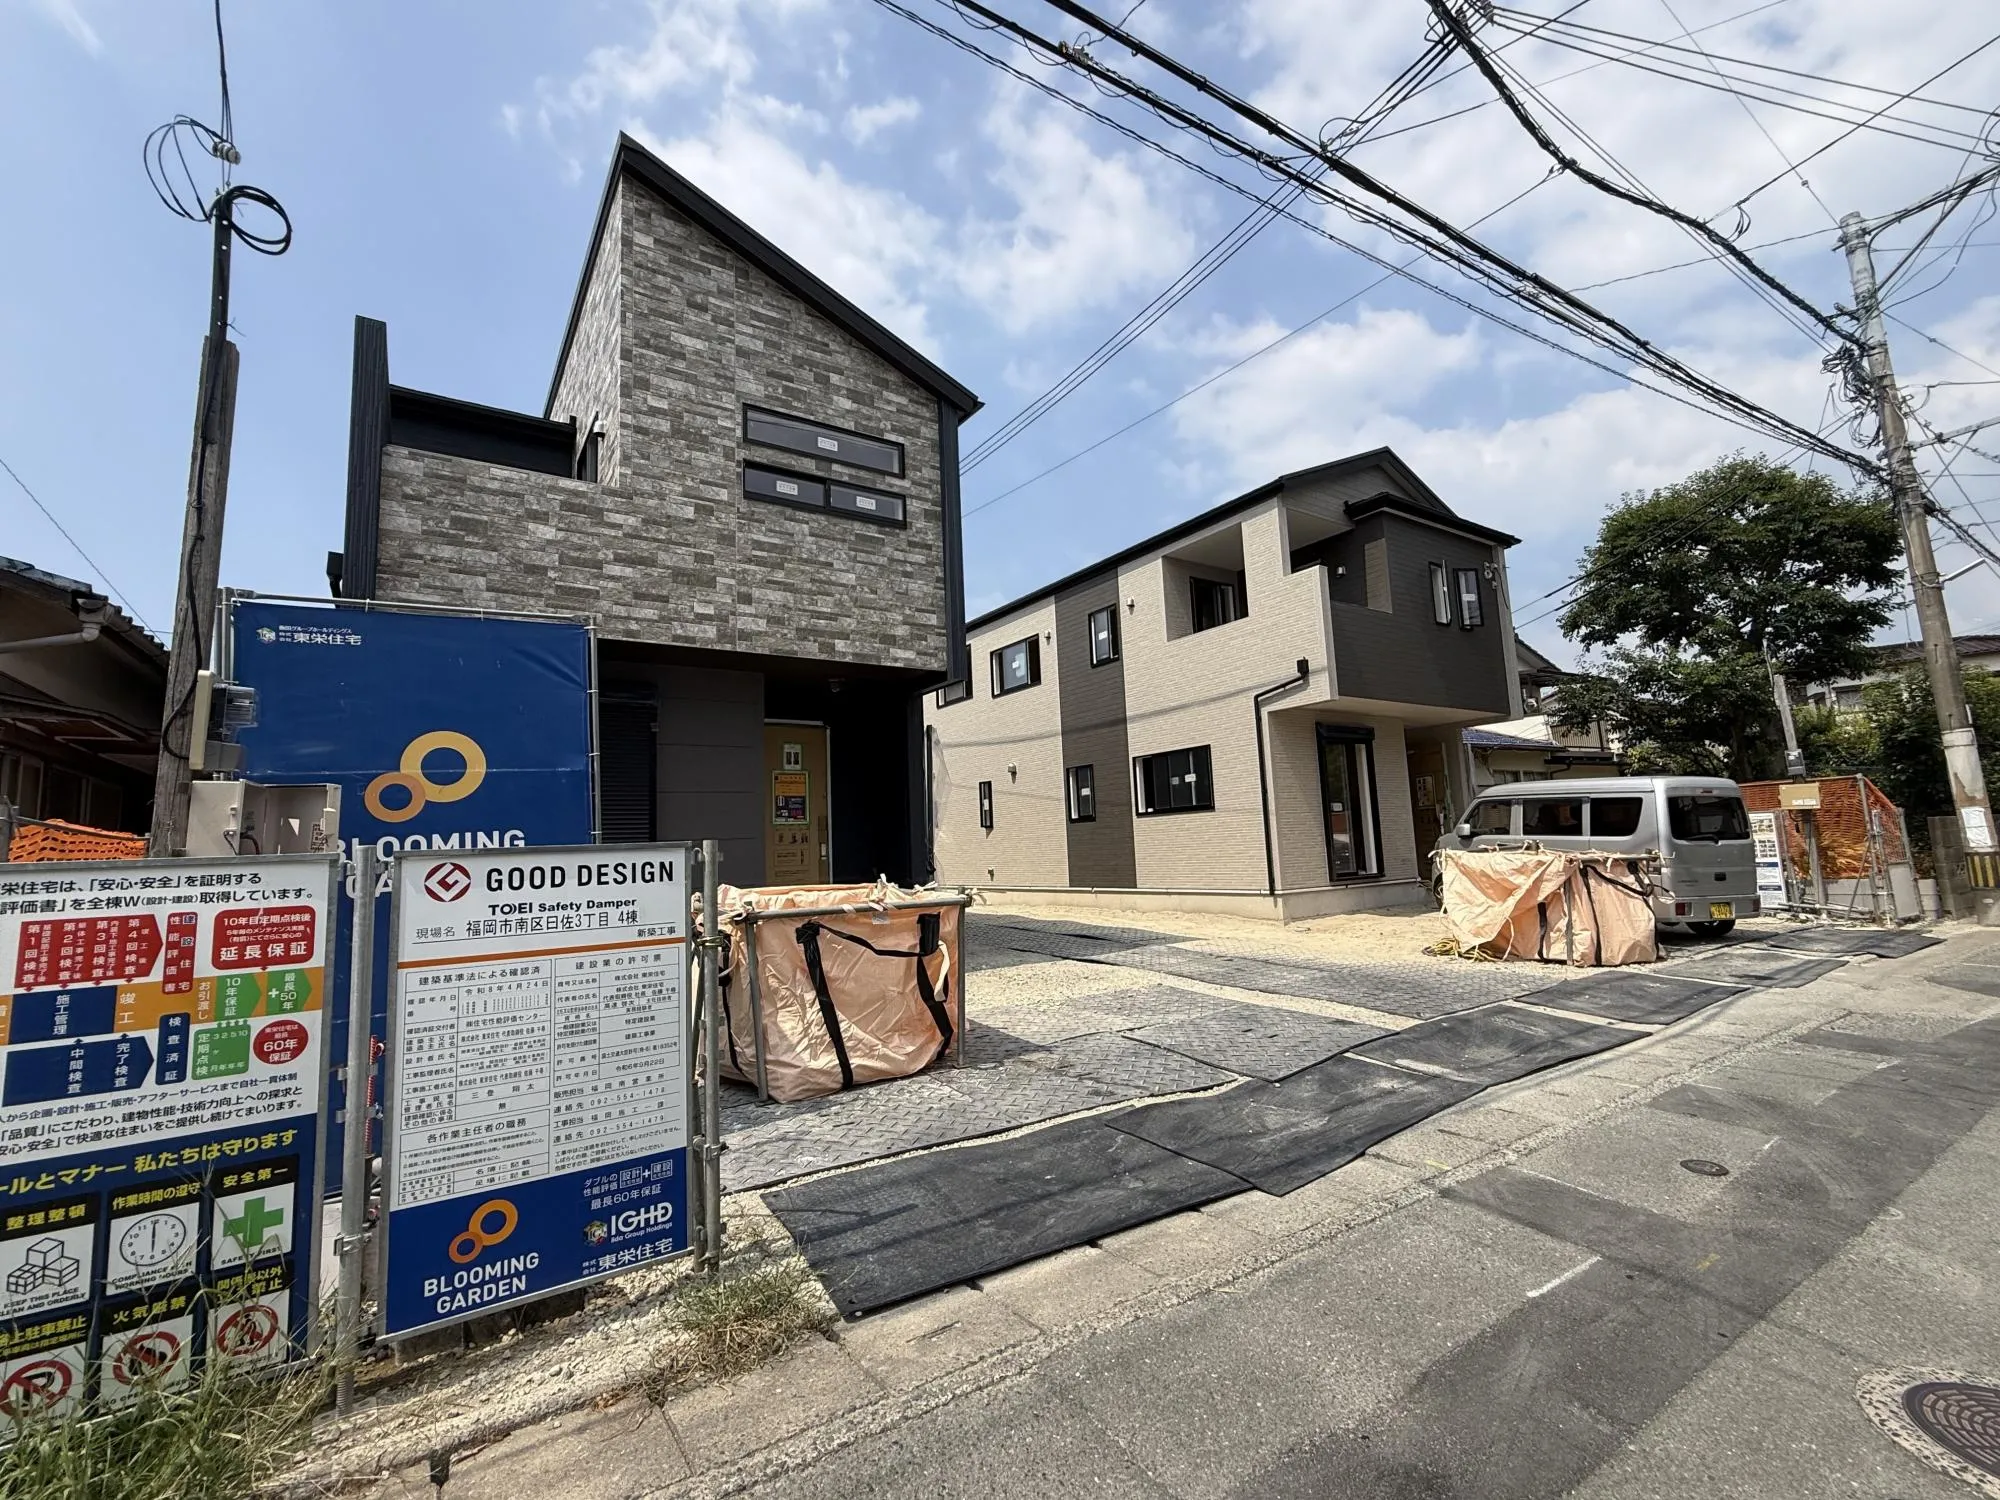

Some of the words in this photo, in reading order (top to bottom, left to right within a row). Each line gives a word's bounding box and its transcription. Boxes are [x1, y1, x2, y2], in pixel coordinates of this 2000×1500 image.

[293, 632, 362, 646] 東栄住宅
[486, 866, 566, 892] GOOD
[577, 861, 674, 887] DESIGN
[224, 913, 311, 926] 10年目定期点検後
[538, 901, 582, 914] Safety
[587, 898, 637, 912] Damper
[416, 926, 456, 940] 現場名
[466, 911, 609, 938] 福岡市南区日佐3丁目
[618, 909, 639, 924] 4棟
[637, 926, 677, 938] 新築工事
[22, 924, 41, 984] 第1回検査
[58, 922, 76, 981] 第2回検査
[92, 920, 109, 978] 第3回検査
[124, 918, 140, 975] 第4回検査
[220, 941, 308, 961] 延長保証
[419, 965, 541, 986] 建築基準法による確認済
[575, 954, 662, 970] 建設業の許可票
[614, 973, 639, 981] 株式会社
[197, 981, 211, 1020] お引渡し
[224, 977, 241, 1017] 10年保証
[280, 972, 297, 1010] 最長50年
[52, 994, 70, 1036] 施工管理
[118, 992, 136, 1024] 竣工
[164, 1017, 181, 1081] 検査済証
[195, 1032, 211, 1076] 定期点検
[263, 1038, 298, 1052] 60年
[269, 1052, 291, 1063] 保証
[67, 1048, 85, 1095] 中間検査
[114, 1042, 131, 1088] 完了検査
[553, 1087, 584, 1099] 販売担当
[553, 1102, 584, 1113] 連絡先
[427, 1118, 527, 1144] 各作業主任者の職務
[553, 1116, 584, 1129] 工事担当
[134, 1129, 298, 1173] 私たちは守ります
[553, 1131, 584, 1144] 連絡先
[222, 1168, 288, 1188] 安全第一
[583, 1181, 618, 1197] 性能評価
[584, 1173, 618, 1188] ダブルの
[621, 1168, 640, 1181] 設計
[113, 1182, 201, 1210] 作業時間の遵守
[591, 1184, 662, 1210] 最長60年保証
[7, 1203, 86, 1231] 整理整頓
[610, 1202, 673, 1236] IGHD
[624, 1229, 645, 1241] Group
[646, 1222, 673, 1233] Holdings
[598, 1237, 673, 1271] 東栄住宅
[424, 1252, 540, 1297] BLOOMING
[4, 1299, 27, 1309] KEEP
[30, 1293, 49, 1303] THIS
[52, 1286, 80, 1297] PLACE
[27, 1301, 45, 1311] AND
[47, 1292, 86, 1306] ORDERLY
[436, 1275, 527, 1314] GARDEN
